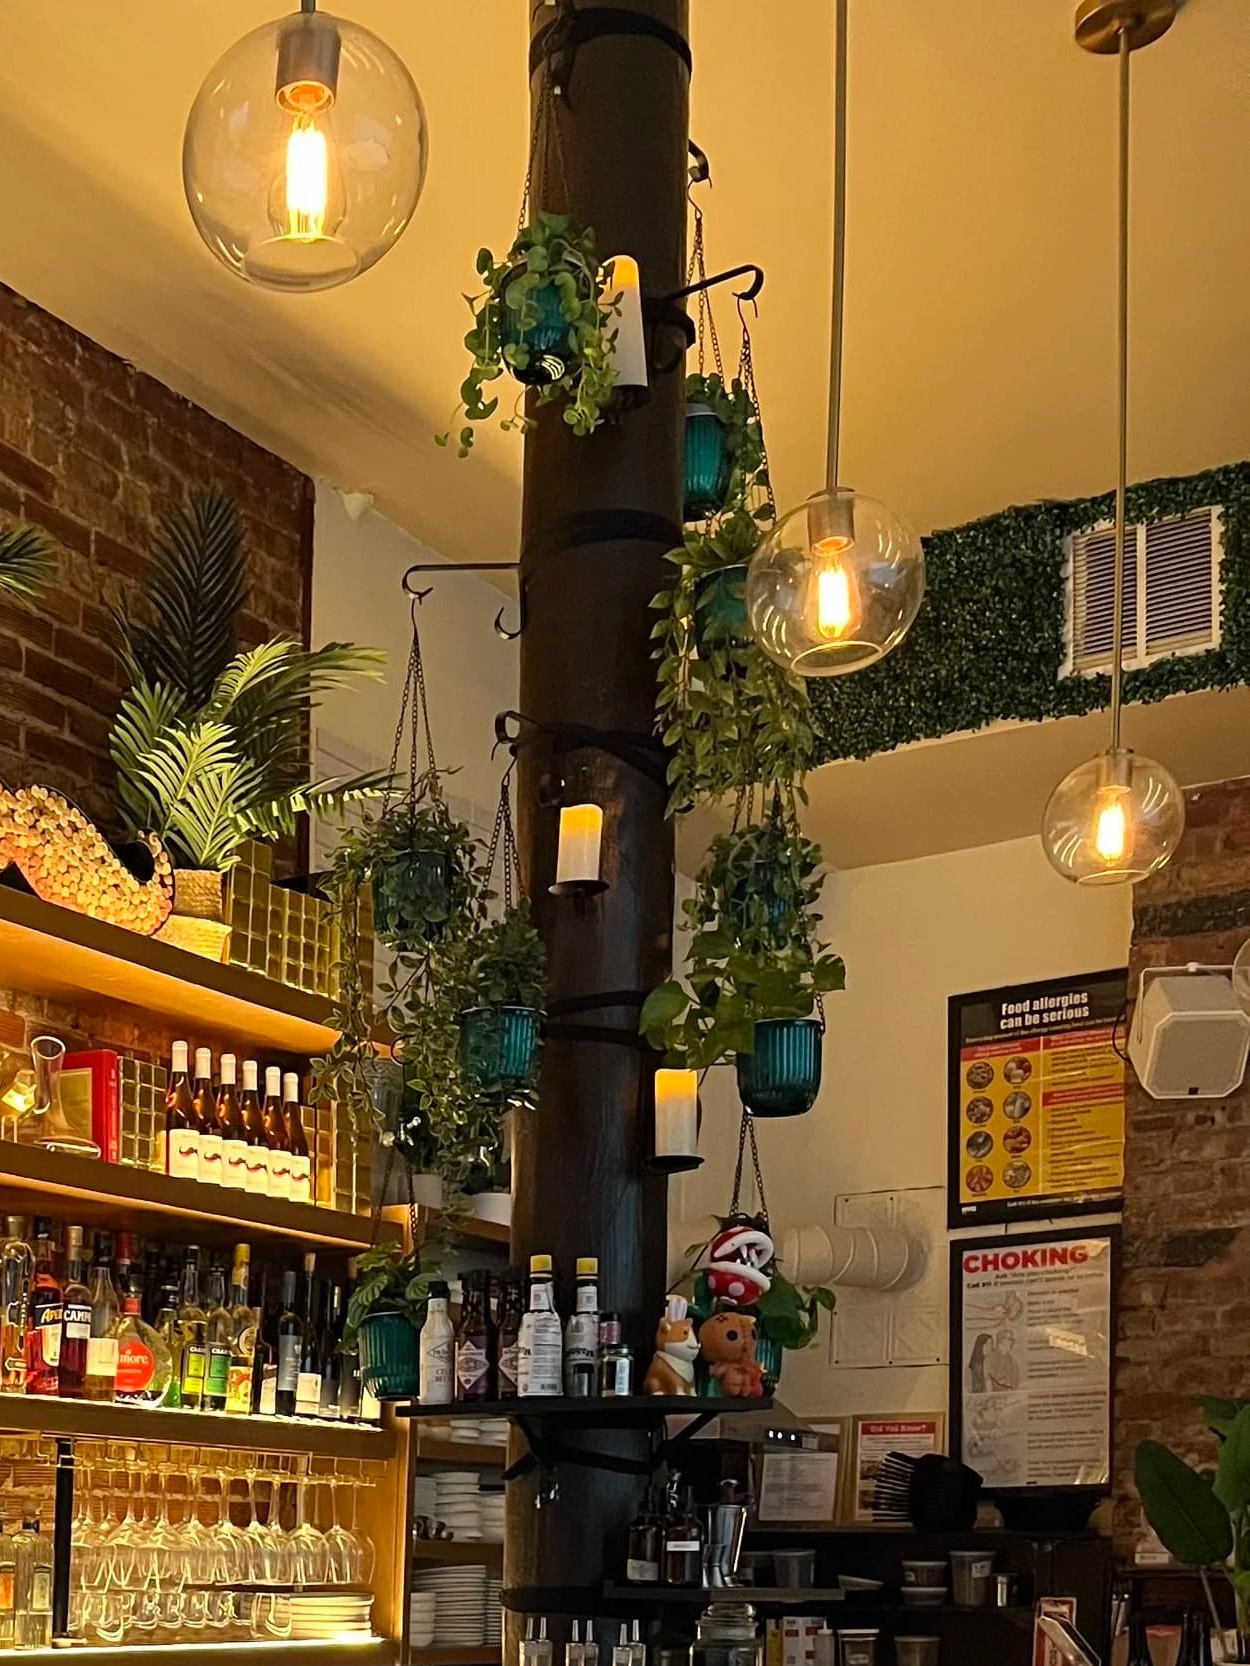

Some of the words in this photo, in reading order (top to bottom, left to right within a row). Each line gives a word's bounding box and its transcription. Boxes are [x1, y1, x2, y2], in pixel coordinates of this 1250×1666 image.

[1002, 1000, 1030, 1016] Food
[1032, 992, 1088, 1011] allergies
[1000, 1017, 1022, 1030] can
[1024, 1013, 1040, 1026] be
[1042, 1006, 1089, 1023] serious
[963, 1245, 1088, 1273] CHOKING
